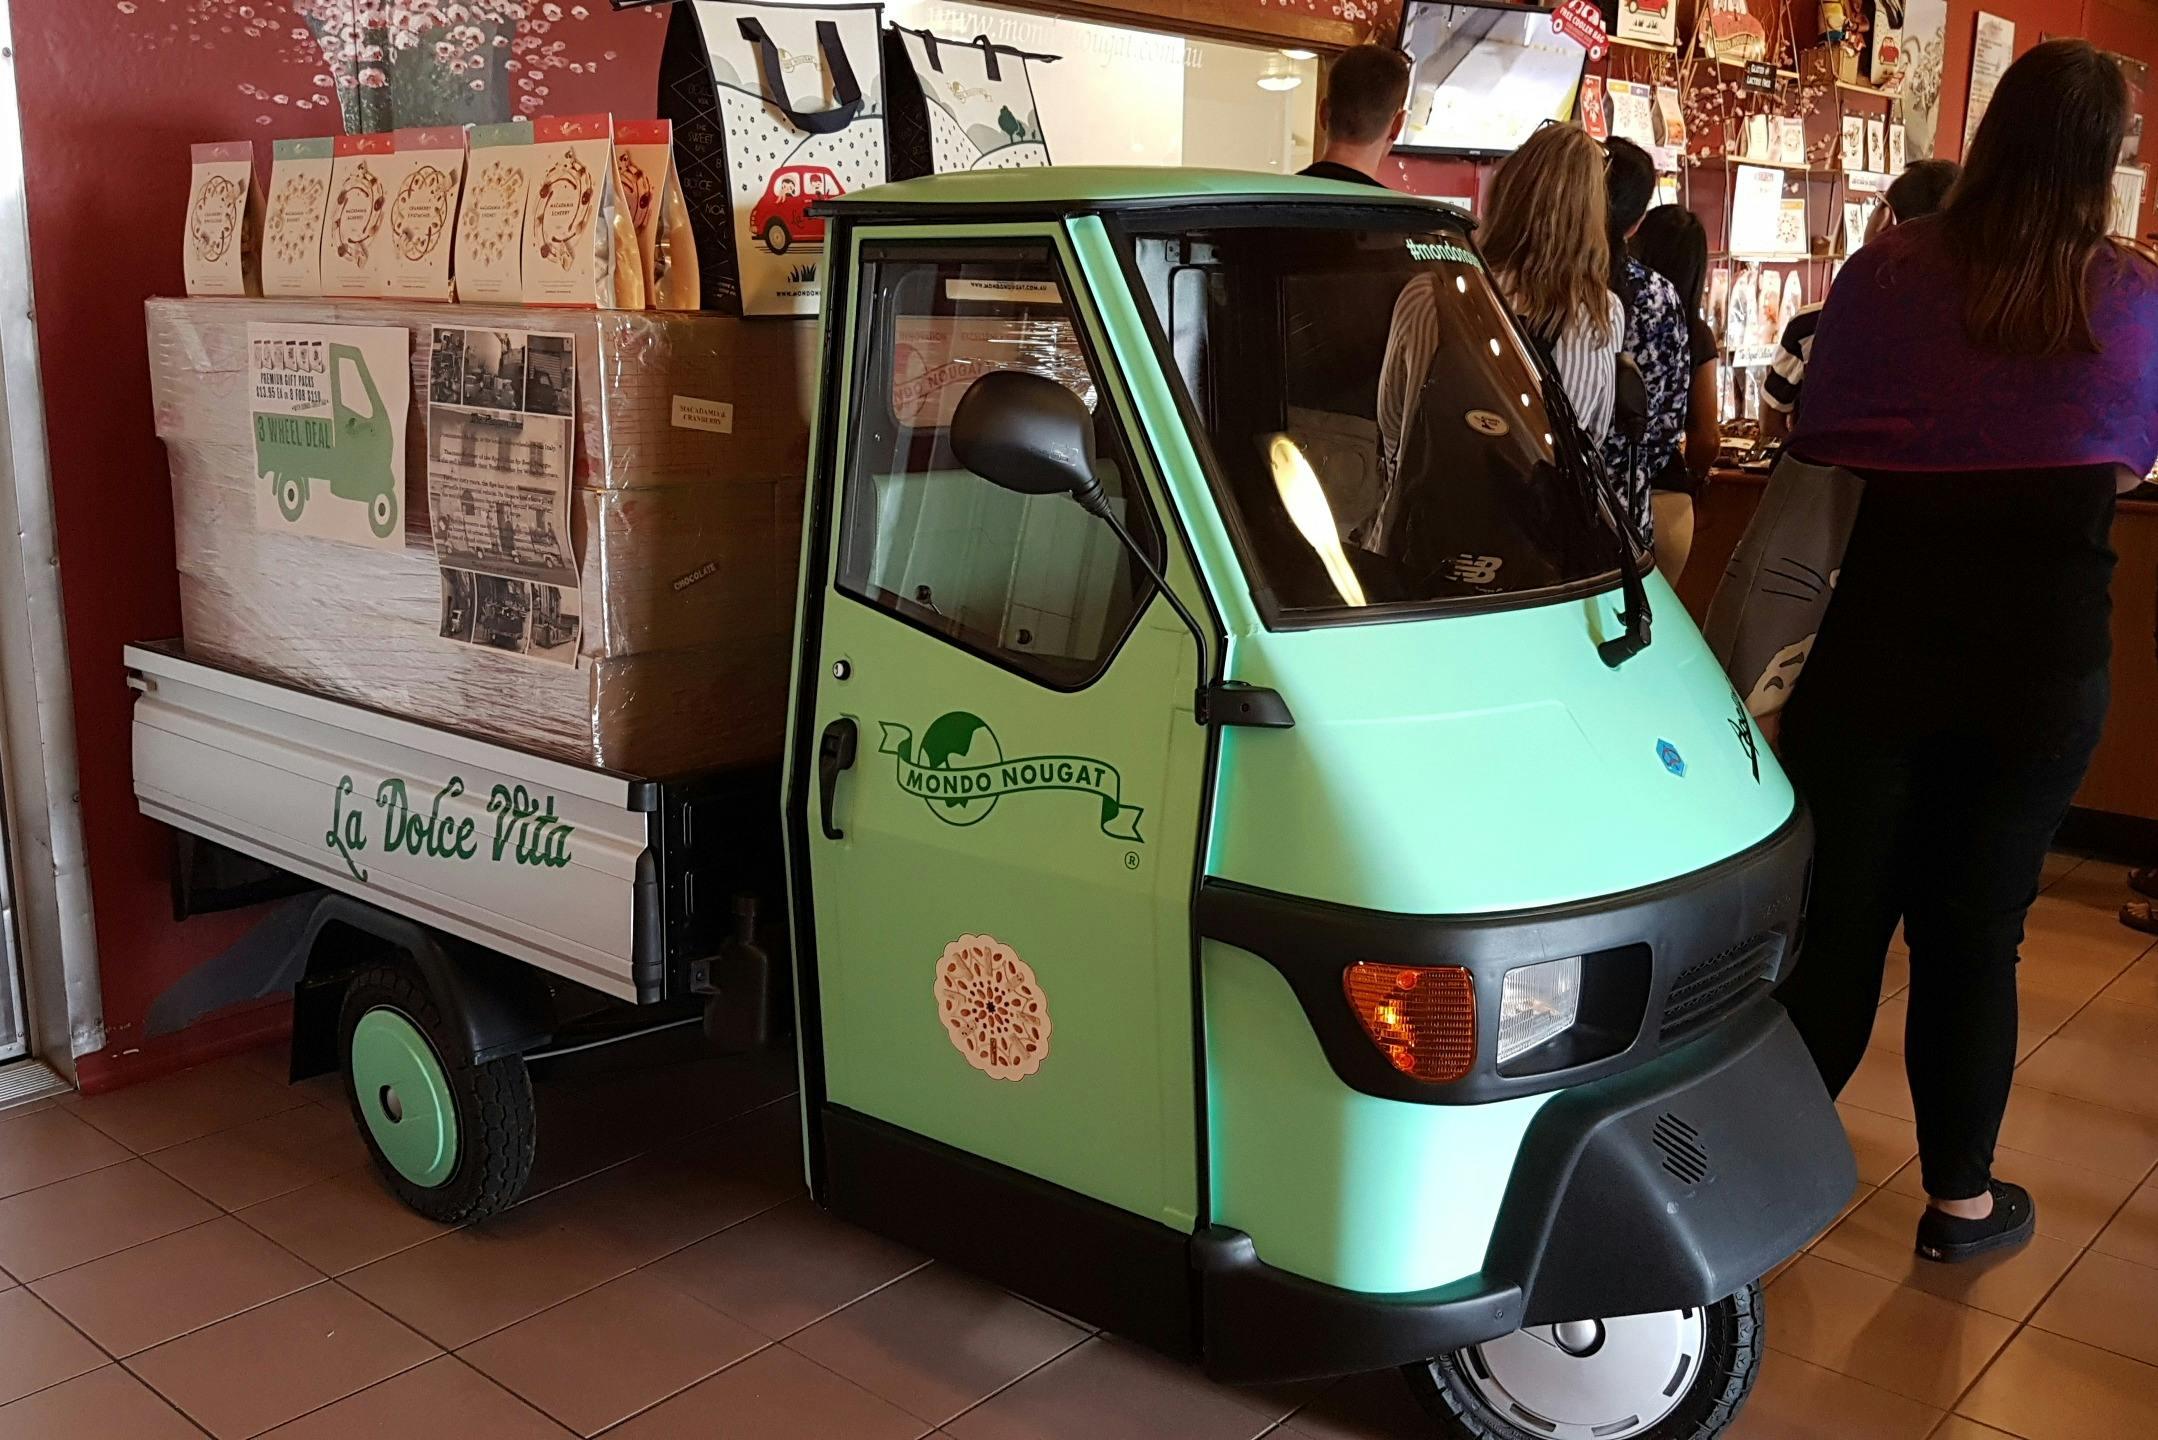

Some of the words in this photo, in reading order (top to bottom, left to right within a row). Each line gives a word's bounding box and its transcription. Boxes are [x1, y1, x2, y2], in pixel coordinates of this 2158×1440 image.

[1572, 15, 1593, 36] COOLER
[1591, 30, 1605, 43] BAG
[256, 386, 276, 399] $13.95
[277, 388, 283, 400] EA
[295, 389, 306, 401] FOR
[260, 372, 283, 386] PREMIUM
[284, 374, 297, 386] GIFT
[298, 375, 315, 387] PACKS
[680, 404, 719, 417] MACADAMIA
[683, 414, 721, 426] CRANBERRY
[258, 416, 265, 442] 3
[268, 418, 302, 447] WHEEL
[306, 420, 332, 449] DEAL
[674, 562, 717, 591] CHOCOLATE
[906, 770, 991, 794] MONDO
[1001, 762, 1106, 788] NOUGAT
[326, 775, 369, 882] La
[376, 775, 478, 860] Dolce
[486, 784, 575, 868] Vita
